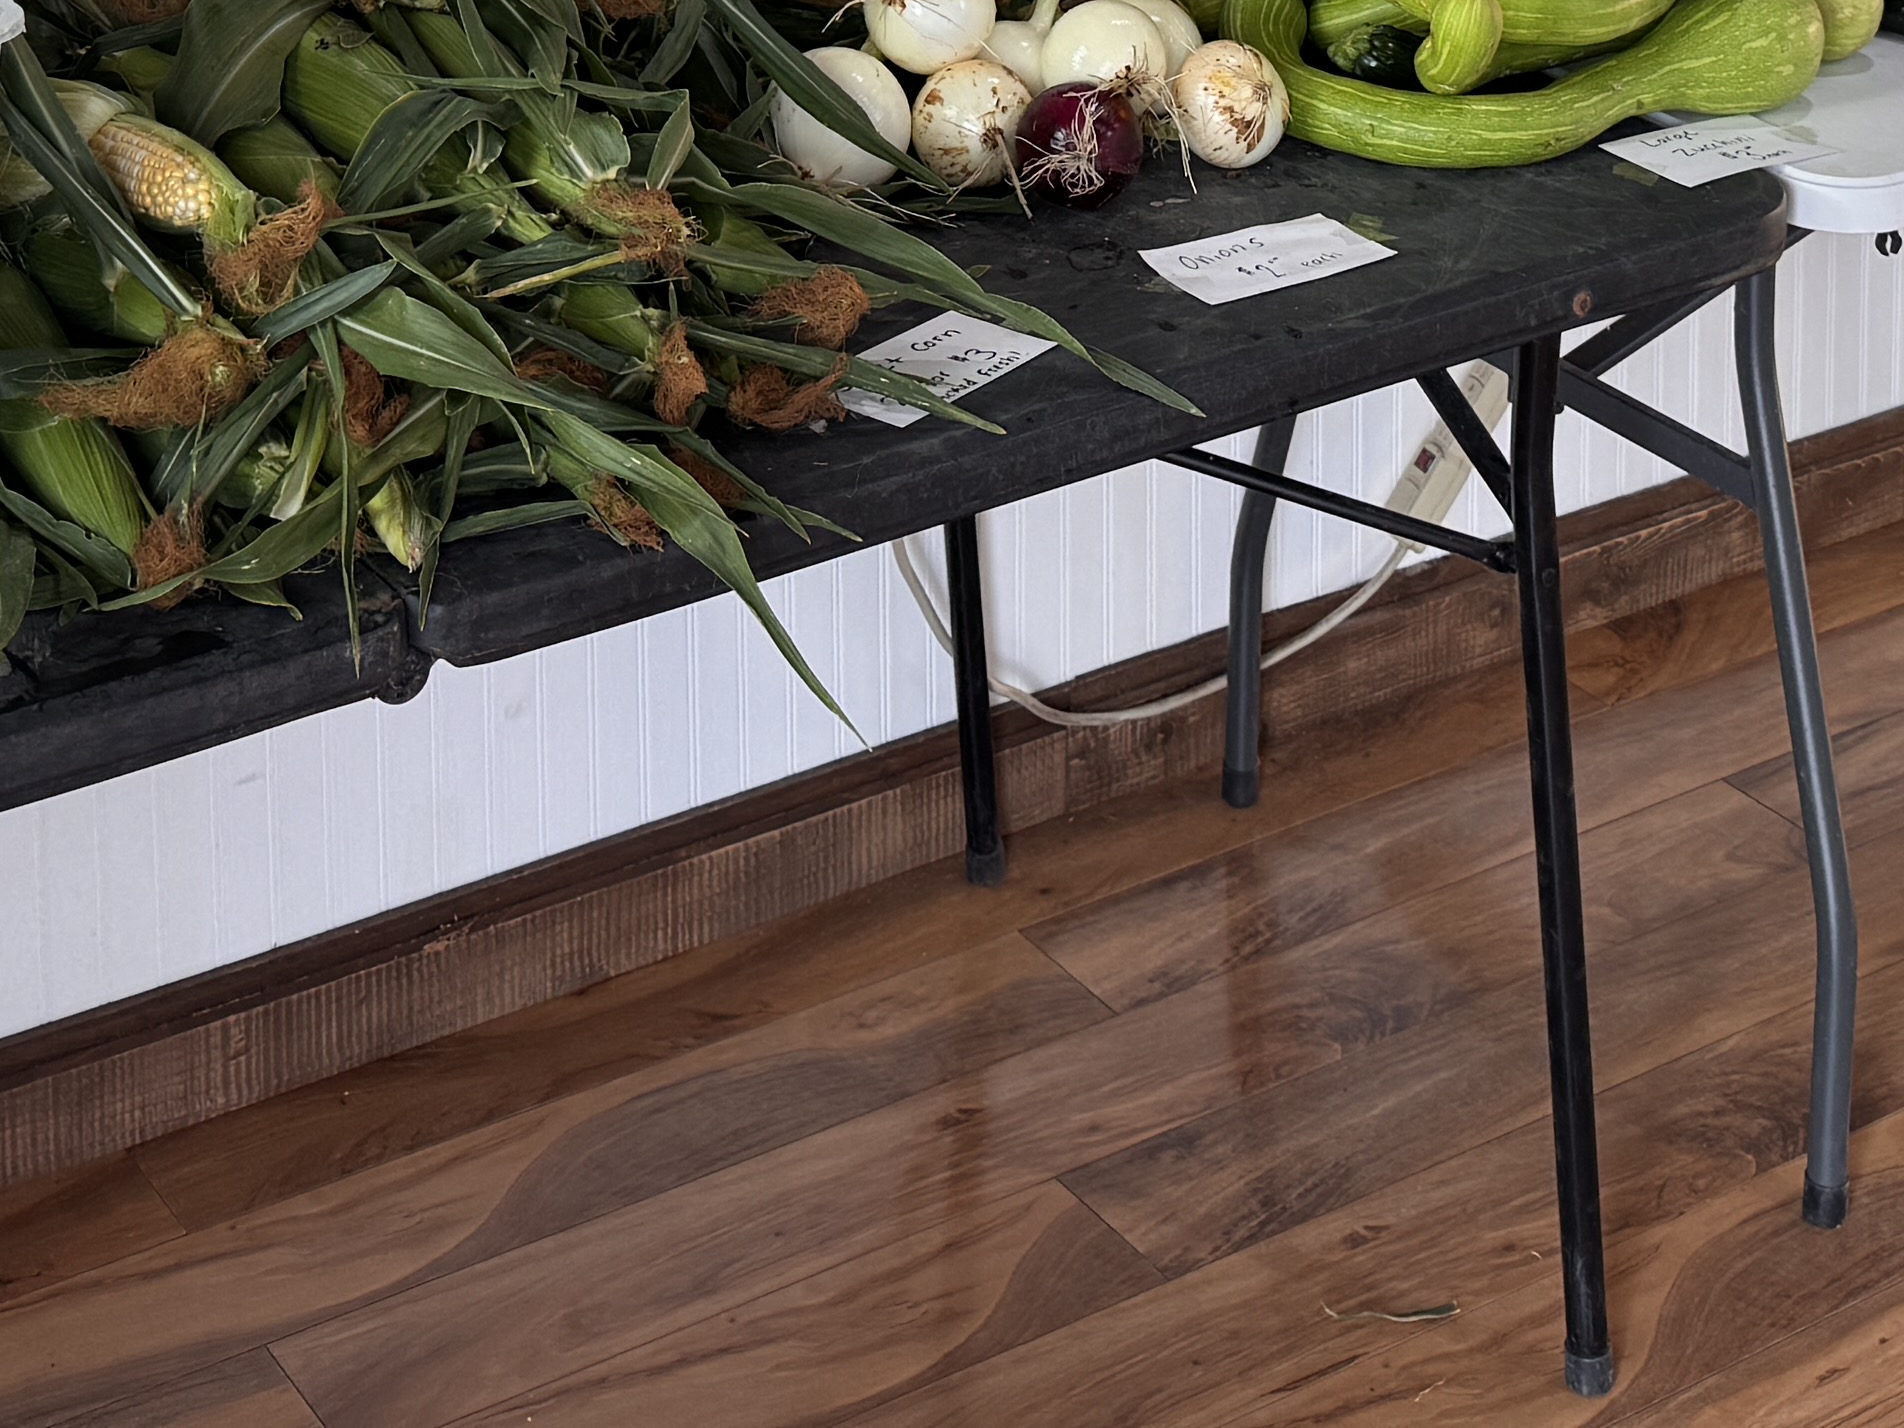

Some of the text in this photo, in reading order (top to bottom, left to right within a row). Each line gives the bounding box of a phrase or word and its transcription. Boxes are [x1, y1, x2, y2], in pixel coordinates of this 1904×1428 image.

[1177, 236, 1265, 271] Onions
[1300, 252, 1344, 268] each
[910, 328, 962, 352] Corn
[946, 348, 997, 362] $3
